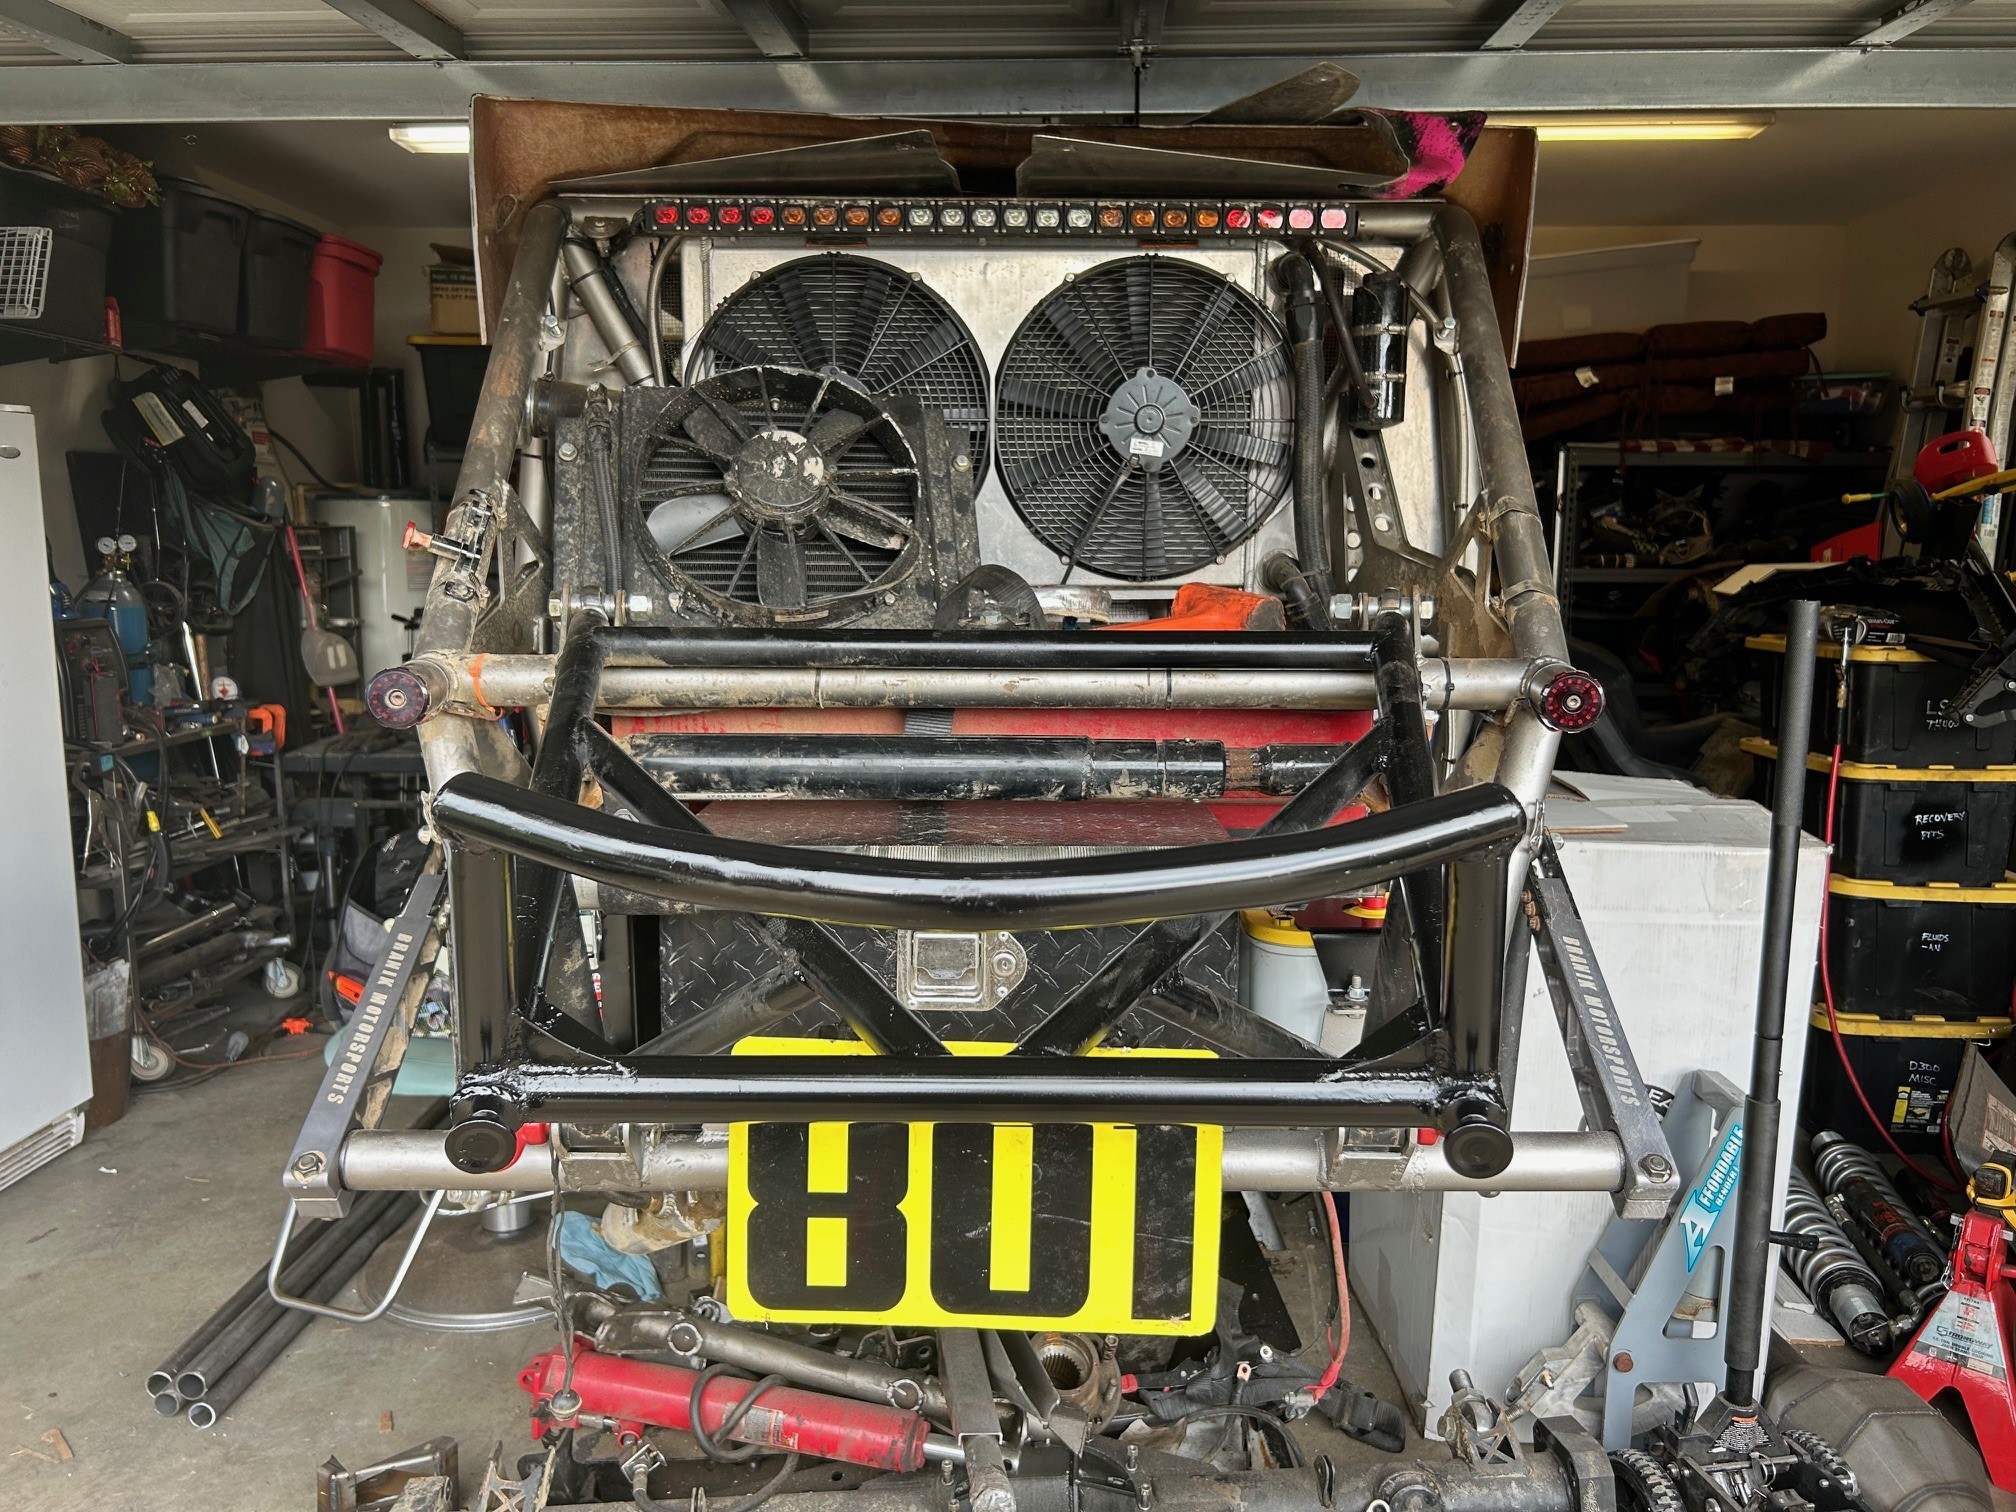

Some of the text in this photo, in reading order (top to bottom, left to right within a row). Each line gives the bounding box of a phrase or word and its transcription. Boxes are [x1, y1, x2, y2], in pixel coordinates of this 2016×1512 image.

[1914, 811, 1966, 825] RECOVERY
[1921, 932, 1950, 942] FLUIDS
[327, 932, 413, 1105] BRANIK MOTORSPORTS
[1562, 935, 1641, 1107] BRANIK MOTORSPORTS
[1908, 1060, 1941, 1072] D300
[1908, 1073, 1938, 1086] MISC
[1714, 1171, 1739, 1208] BENDER
[747, 1123, 1198, 1321] 801
